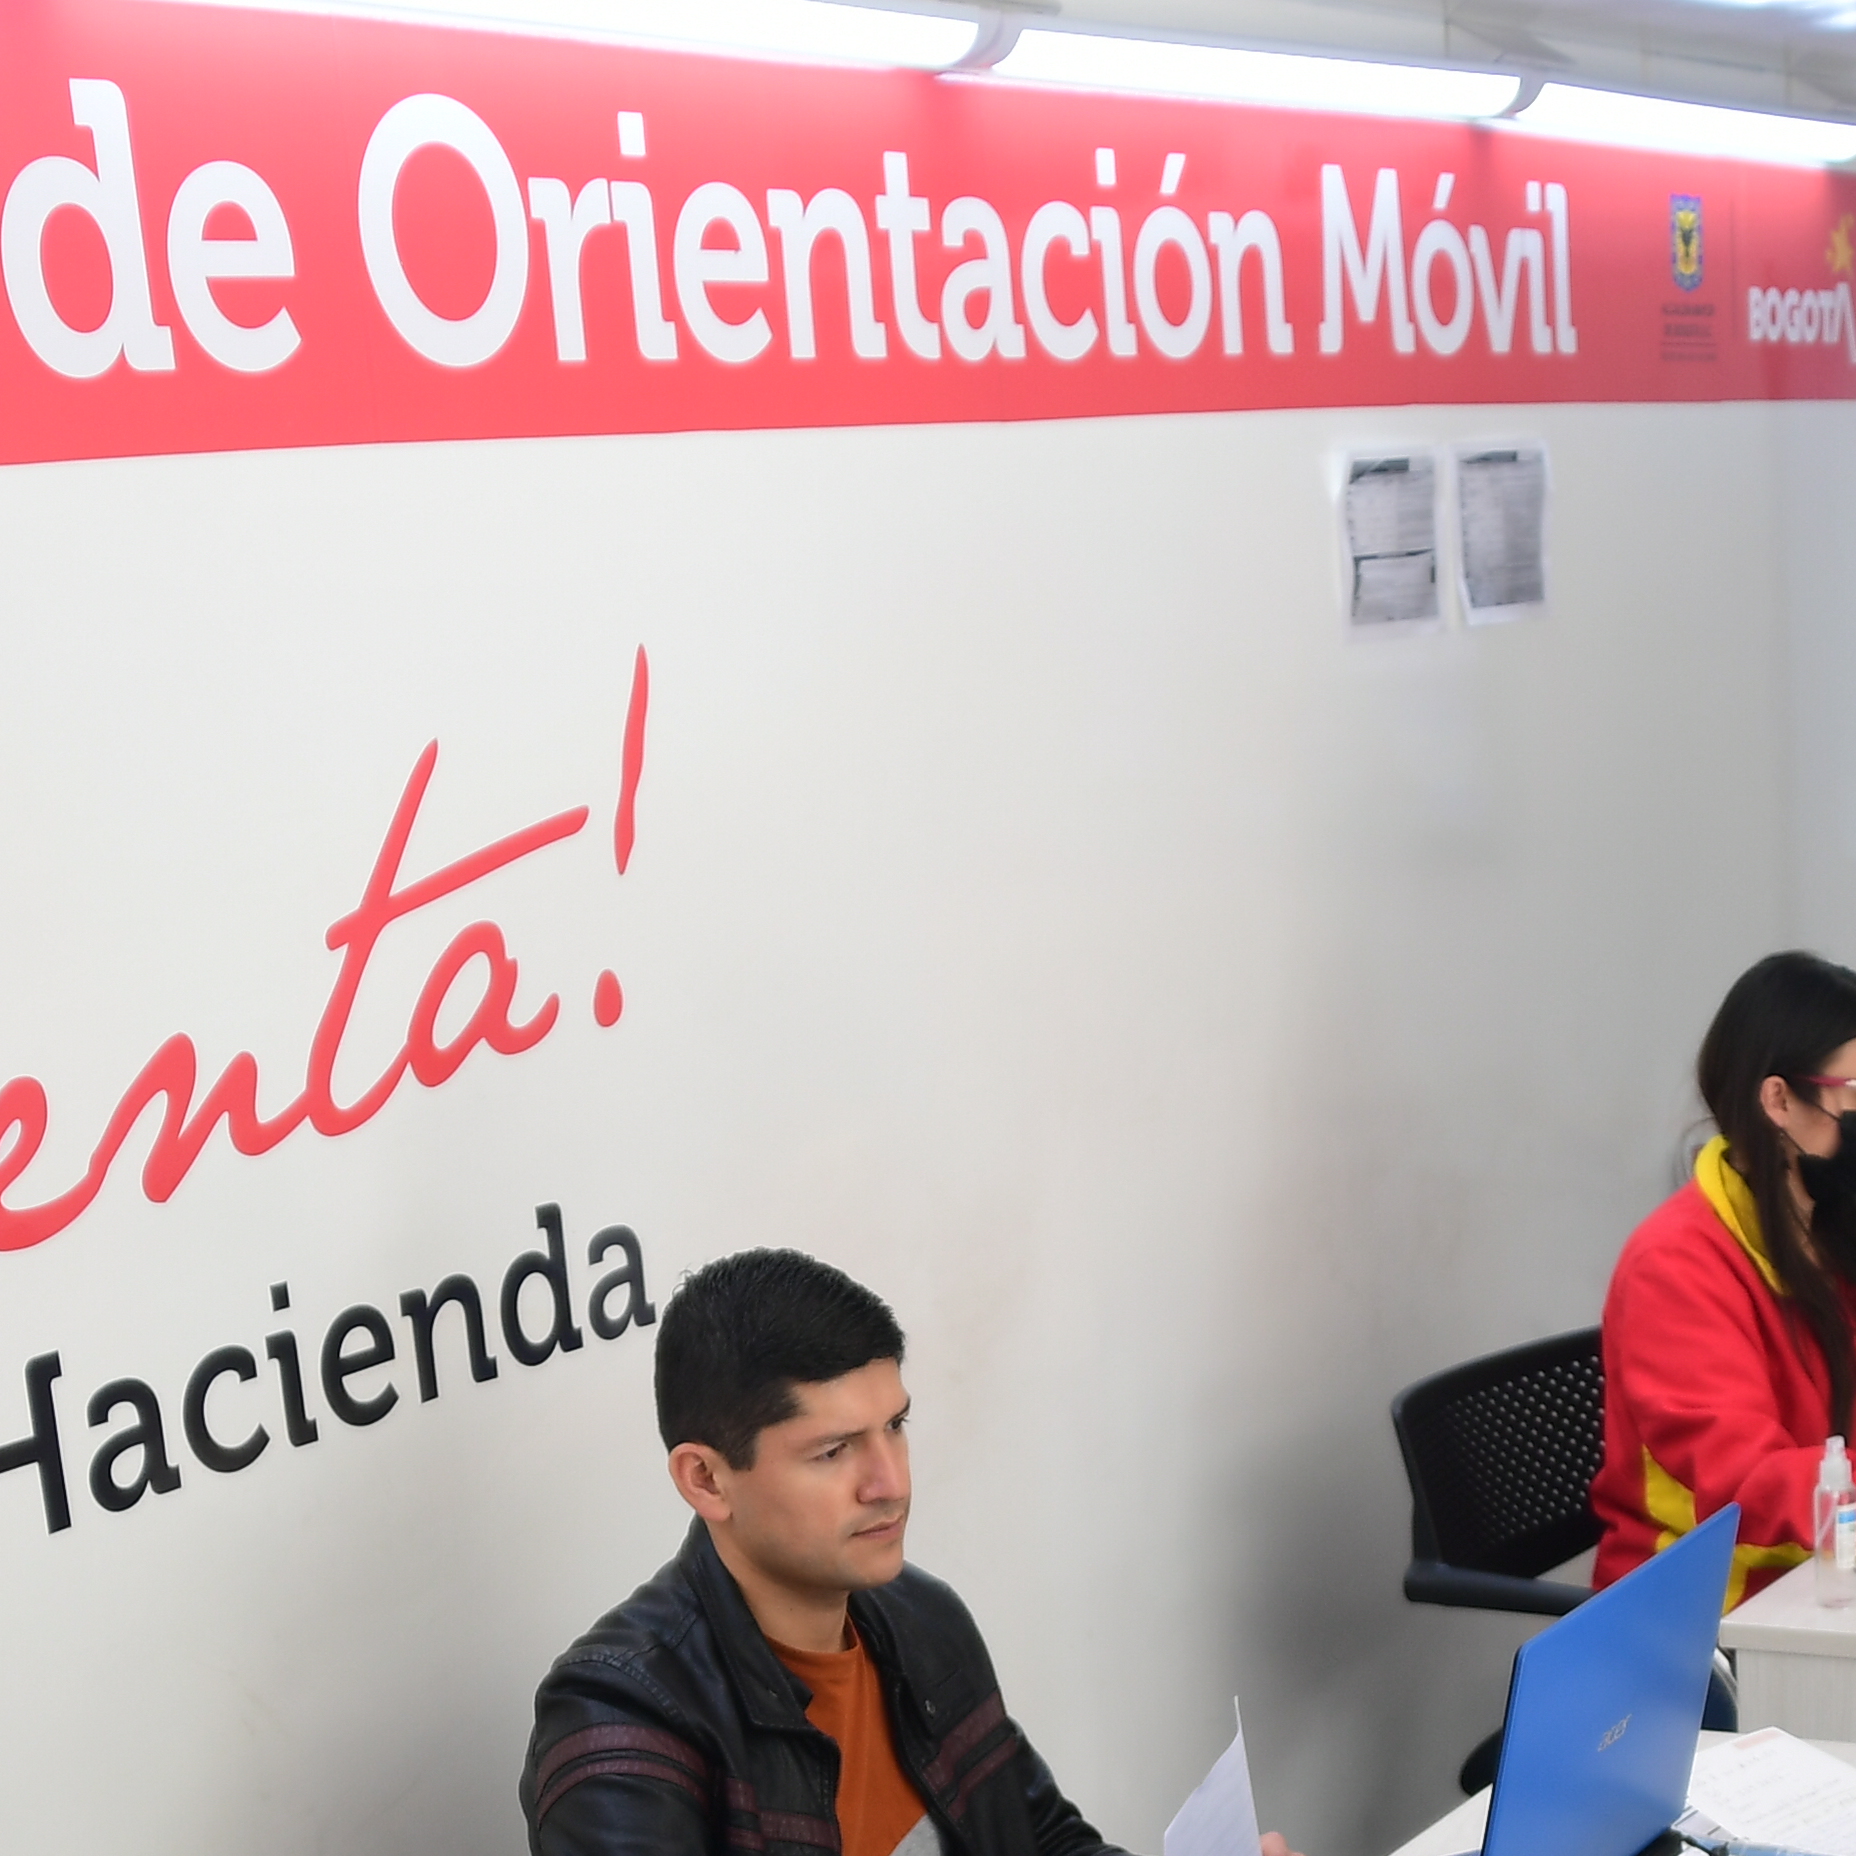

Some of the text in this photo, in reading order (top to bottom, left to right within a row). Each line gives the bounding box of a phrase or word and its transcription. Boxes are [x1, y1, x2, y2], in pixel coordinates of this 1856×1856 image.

[0, 77, 302, 379] de
[357, 92, 1293, 368] Orientación
[1317, 163, 1578, 358] Móvil
